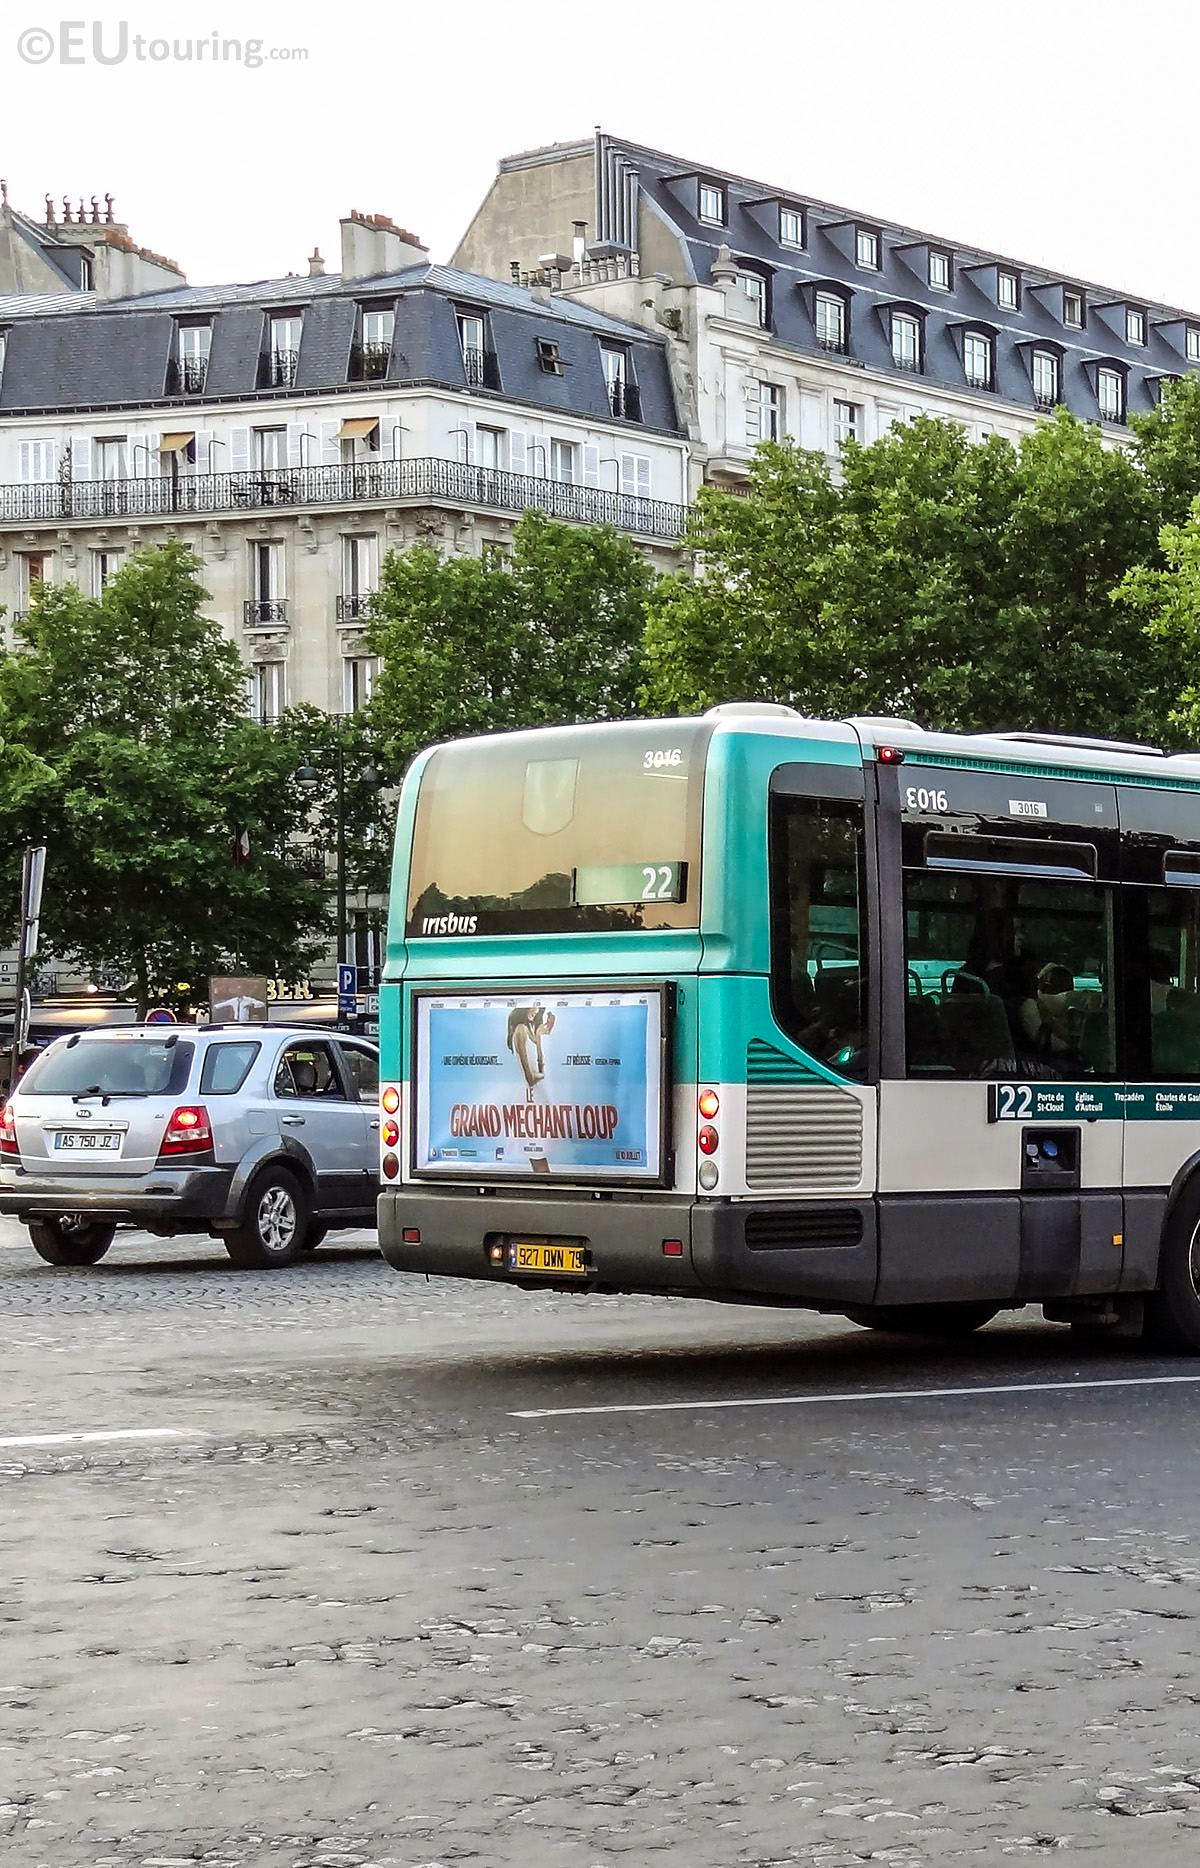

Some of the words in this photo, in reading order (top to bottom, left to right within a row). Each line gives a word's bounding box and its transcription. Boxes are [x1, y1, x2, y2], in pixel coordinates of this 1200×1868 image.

[643, 748, 683, 769] 3016
[1018, 802, 1040, 815] 3016
[641, 866, 673, 899] 22
[343, 970, 352, 990] P
[1000, 1085, 1033, 1118] 22
[1037, 1093, 1054, 1102] Porte
[1055, 1092, 1065, 1102] de
[1155, 1093, 1177, 1102] Charles
[1178, 1093, 1186, 1102] de
[1037, 1103, 1064, 1112] St-Cloud
[450, 1104, 502, 1137] GRAND
[575, 1105, 619, 1140] LOUP
[519, 1248, 539, 1266] 927
